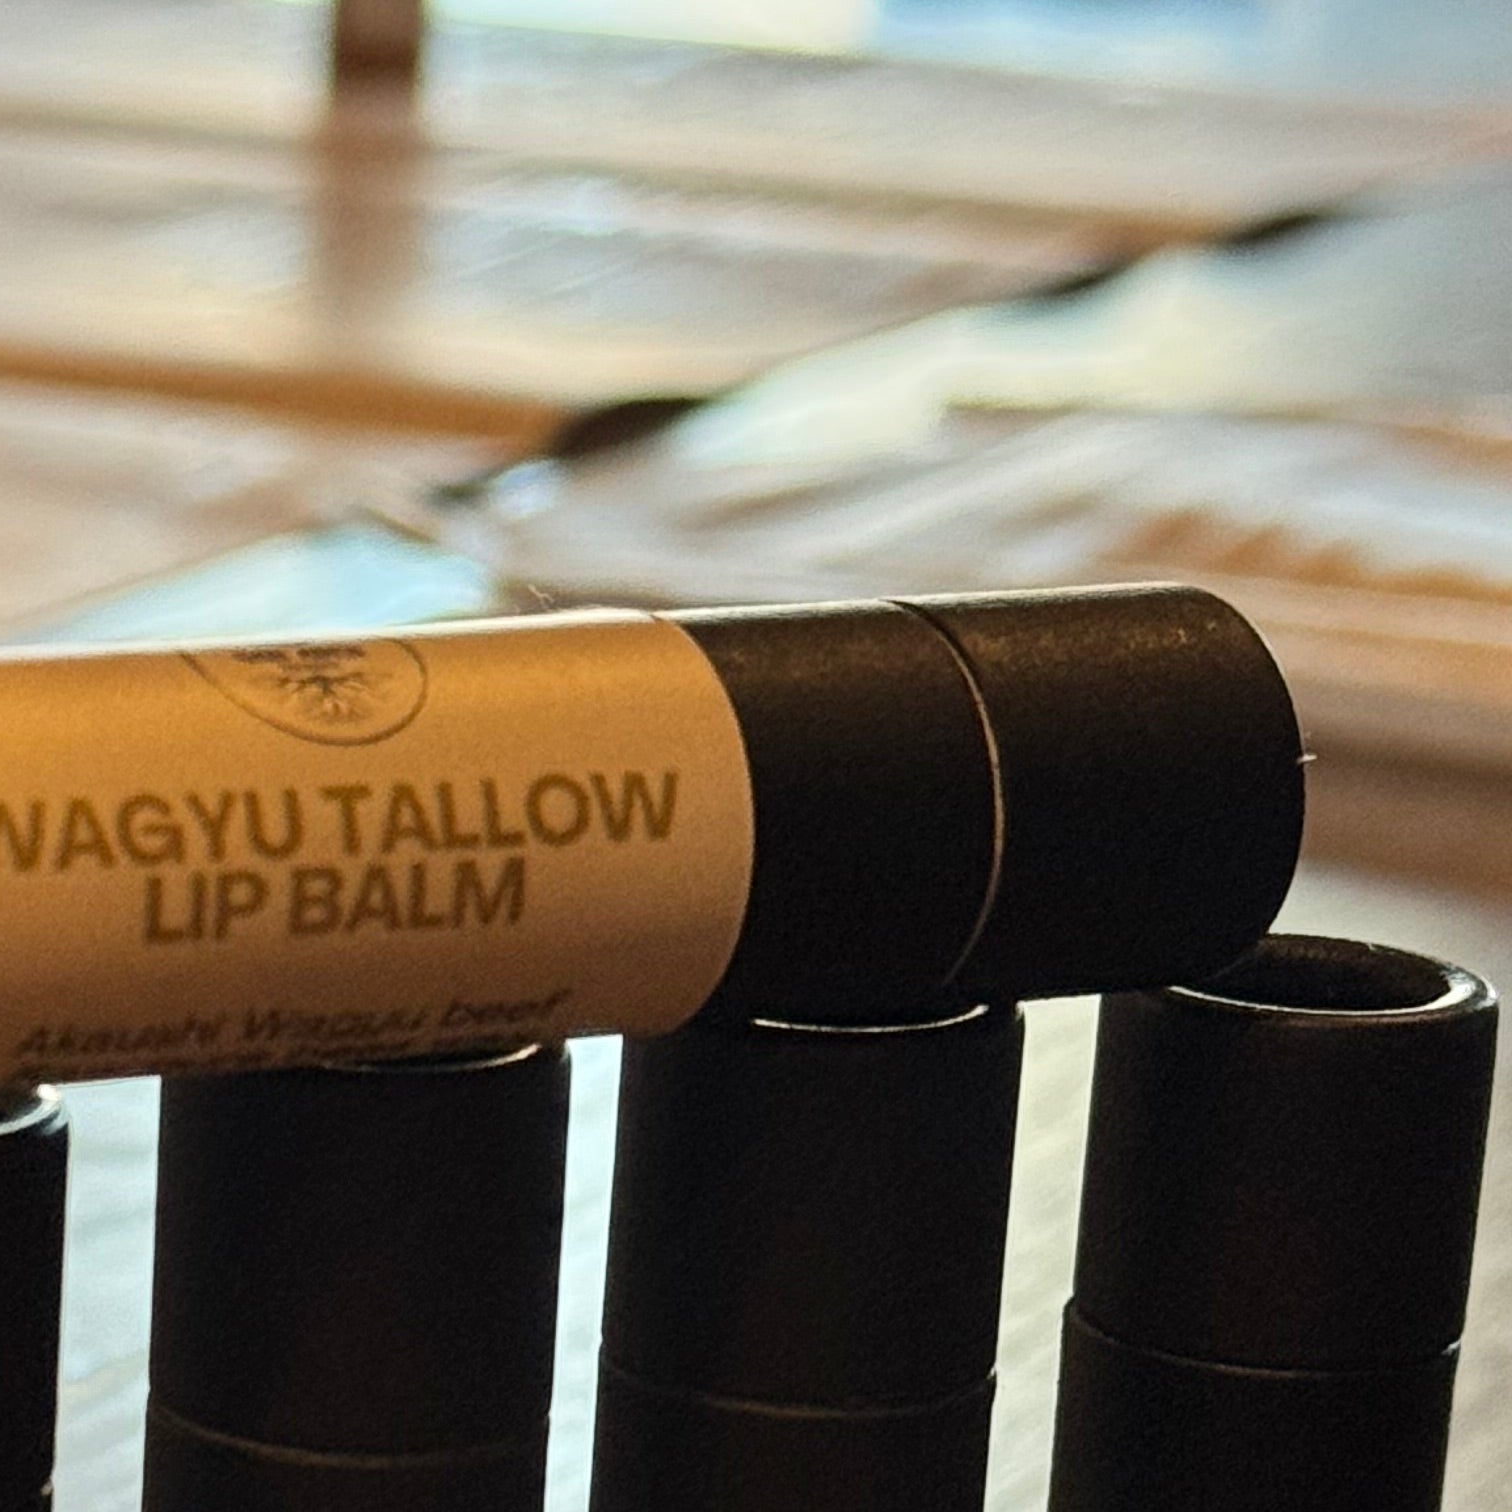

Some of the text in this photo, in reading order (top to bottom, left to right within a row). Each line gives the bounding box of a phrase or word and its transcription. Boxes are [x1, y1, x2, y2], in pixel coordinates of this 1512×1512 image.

[326, 772, 679, 854] TALLOW
[142, 858, 526, 947] LIP BALM
